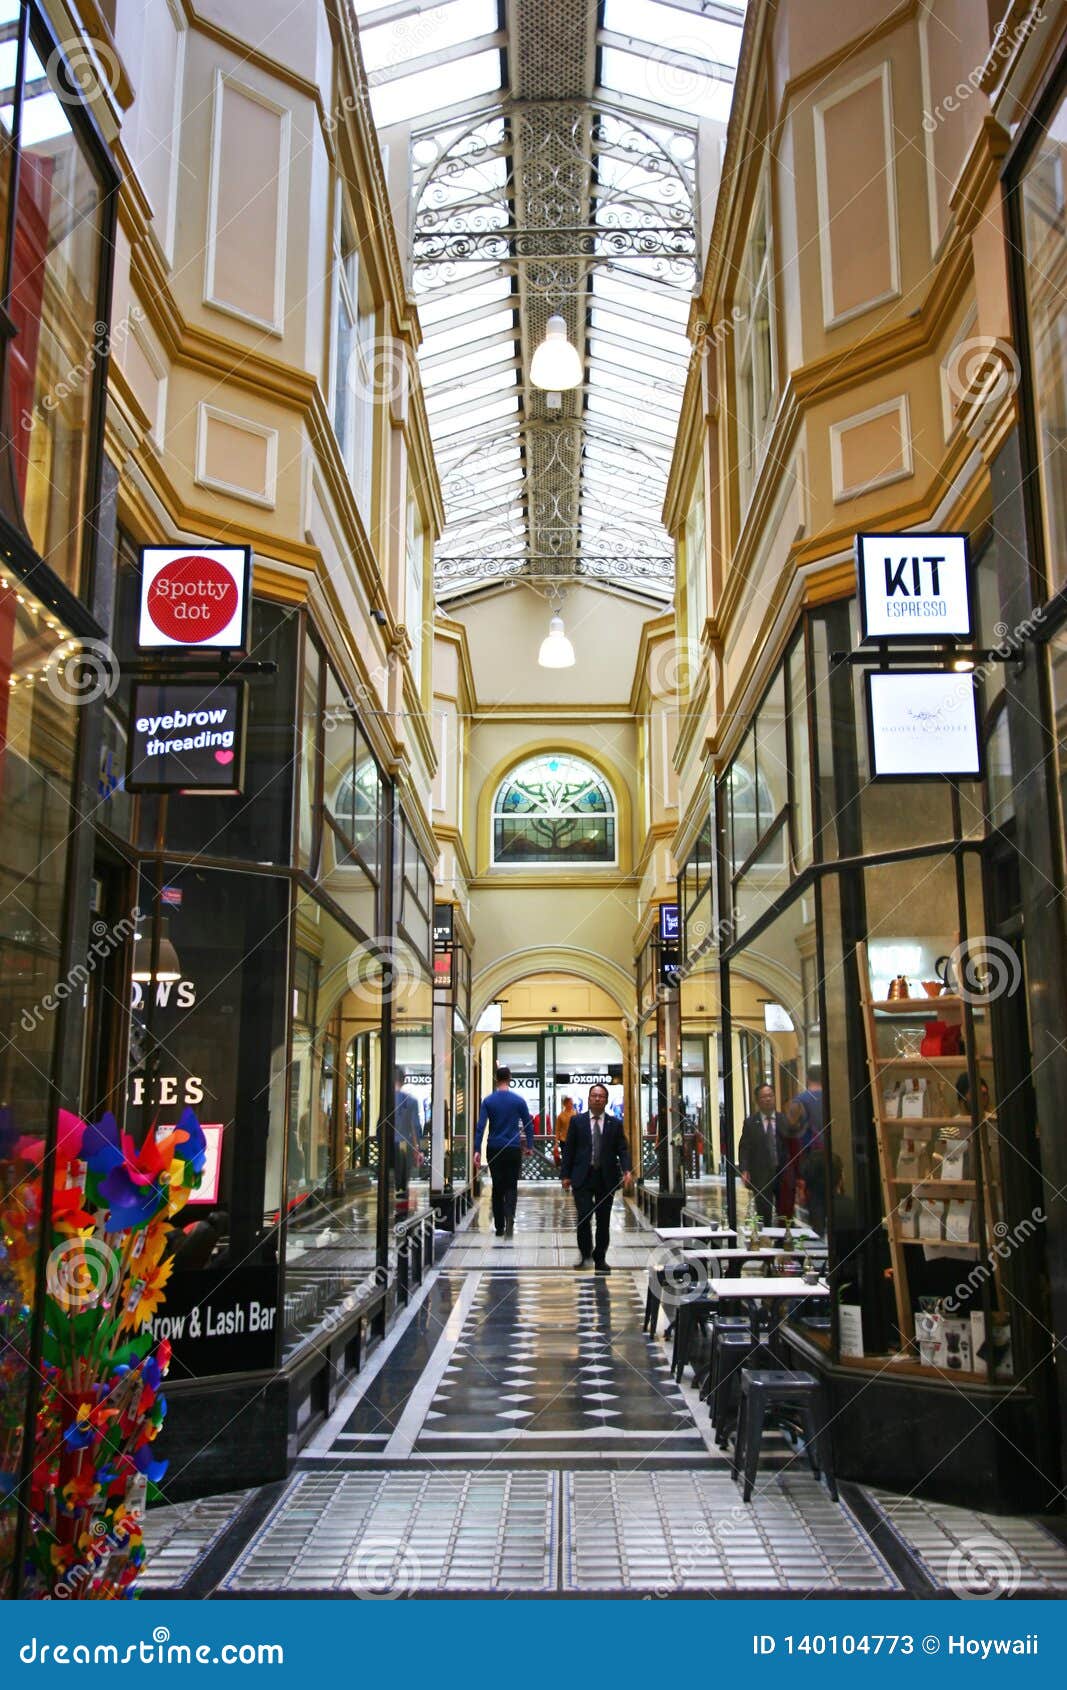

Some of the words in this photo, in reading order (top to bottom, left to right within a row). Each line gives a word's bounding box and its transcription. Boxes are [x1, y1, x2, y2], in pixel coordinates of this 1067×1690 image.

[884, 557, 946, 596] KIT
[156, 579, 231, 600] Spotty
[174, 603, 211, 619] dot
[886, 601, 946, 617] ESPRESSO
[136, 709, 227, 735] eyebrow
[146, 731, 234, 756] threading
[569, 1074, 613, 1084] roxanne
[189, 1306, 201, 1338] &
[206, 1304, 244, 1336] Lash
[250, 1301, 277, 1332] Bar
